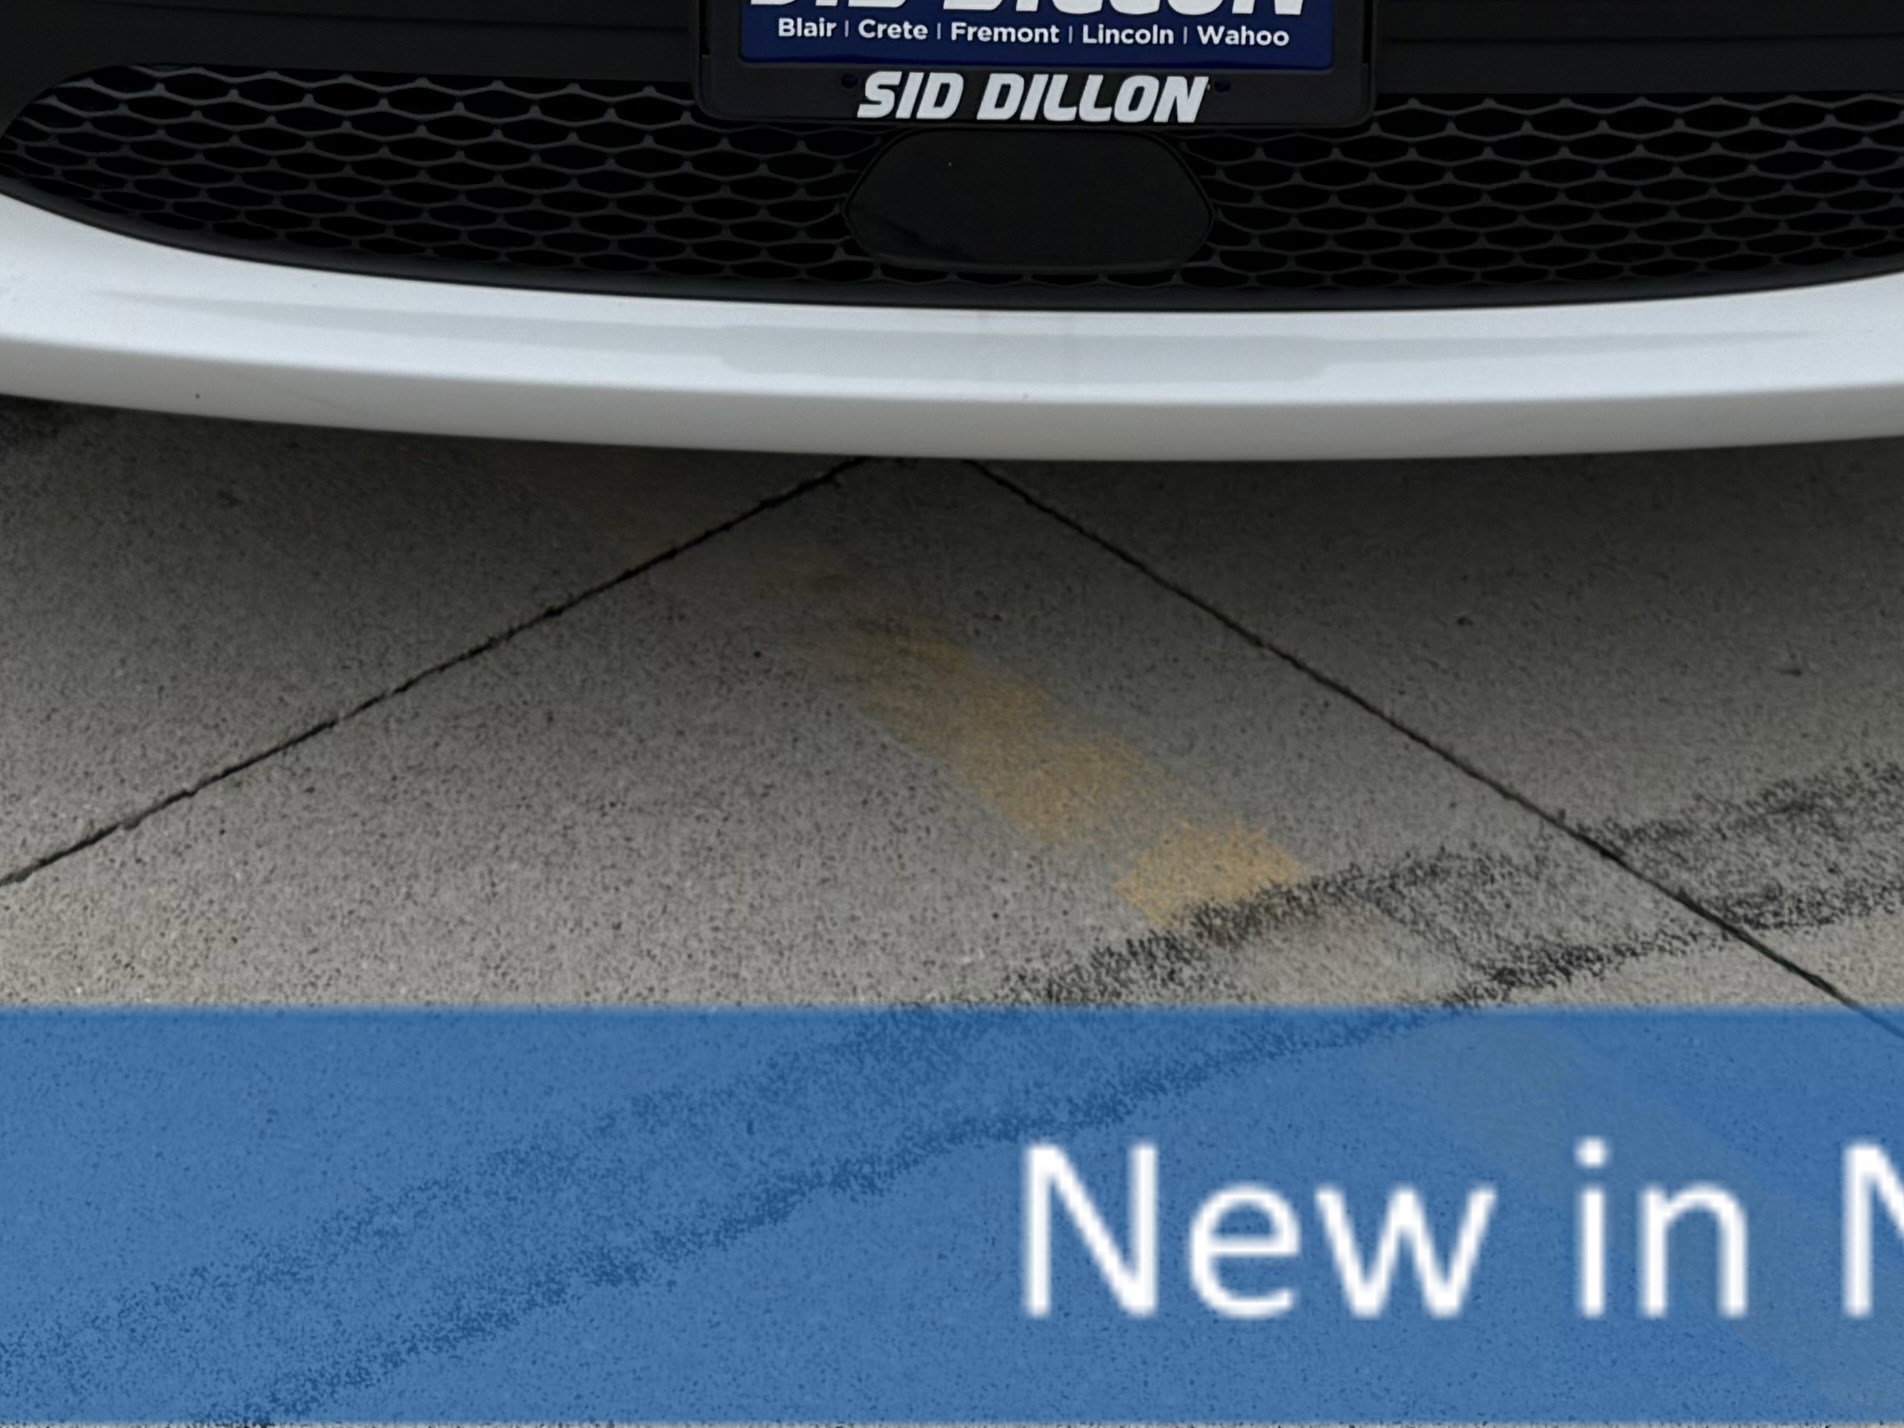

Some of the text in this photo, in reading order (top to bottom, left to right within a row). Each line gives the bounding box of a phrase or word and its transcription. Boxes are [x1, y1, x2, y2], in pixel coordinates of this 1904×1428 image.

[777, 16, 1291, 48] Blair Crete Fremont Lincoln Wahoo
[856, 70, 1210, 124] SID DILLON
